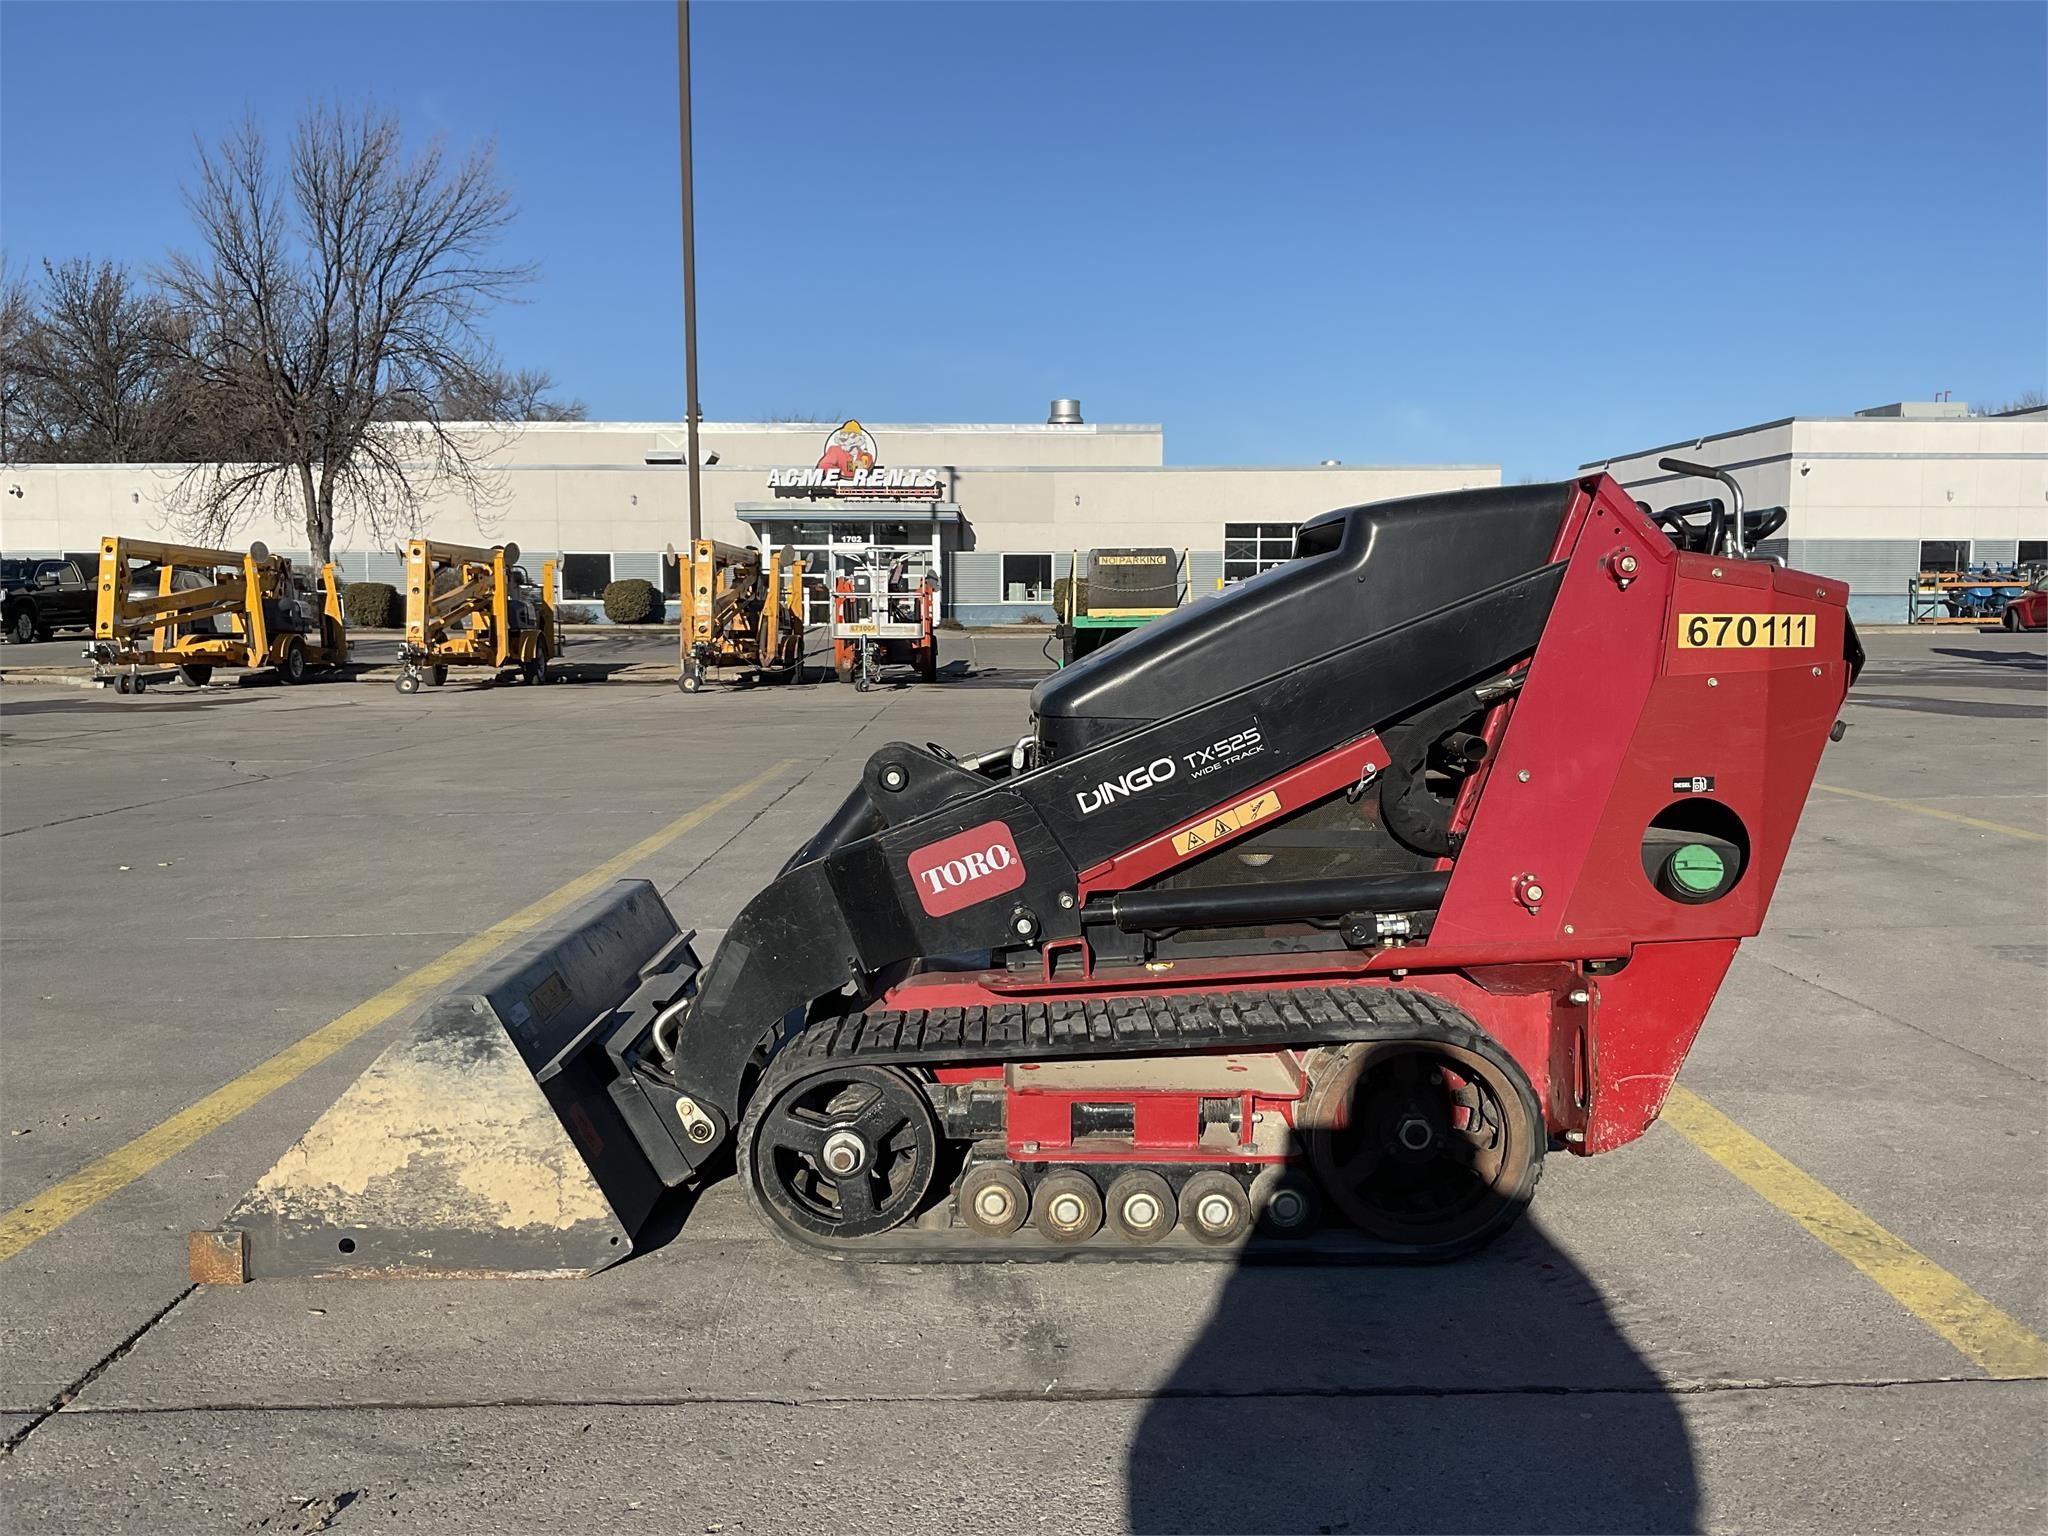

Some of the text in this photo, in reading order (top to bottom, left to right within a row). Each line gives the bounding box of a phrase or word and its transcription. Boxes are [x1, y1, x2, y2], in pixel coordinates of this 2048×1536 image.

[766, 468, 938, 487] ACME RENTS
[841, 535, 863, 543] 1702
[1101, 555, 1165, 565] NO PARKING
[1687, 616, 1808, 647] 670111
[1191, 744, 1265, 779] WIDE TRACK
[1076, 757, 1176, 814] DINGO
